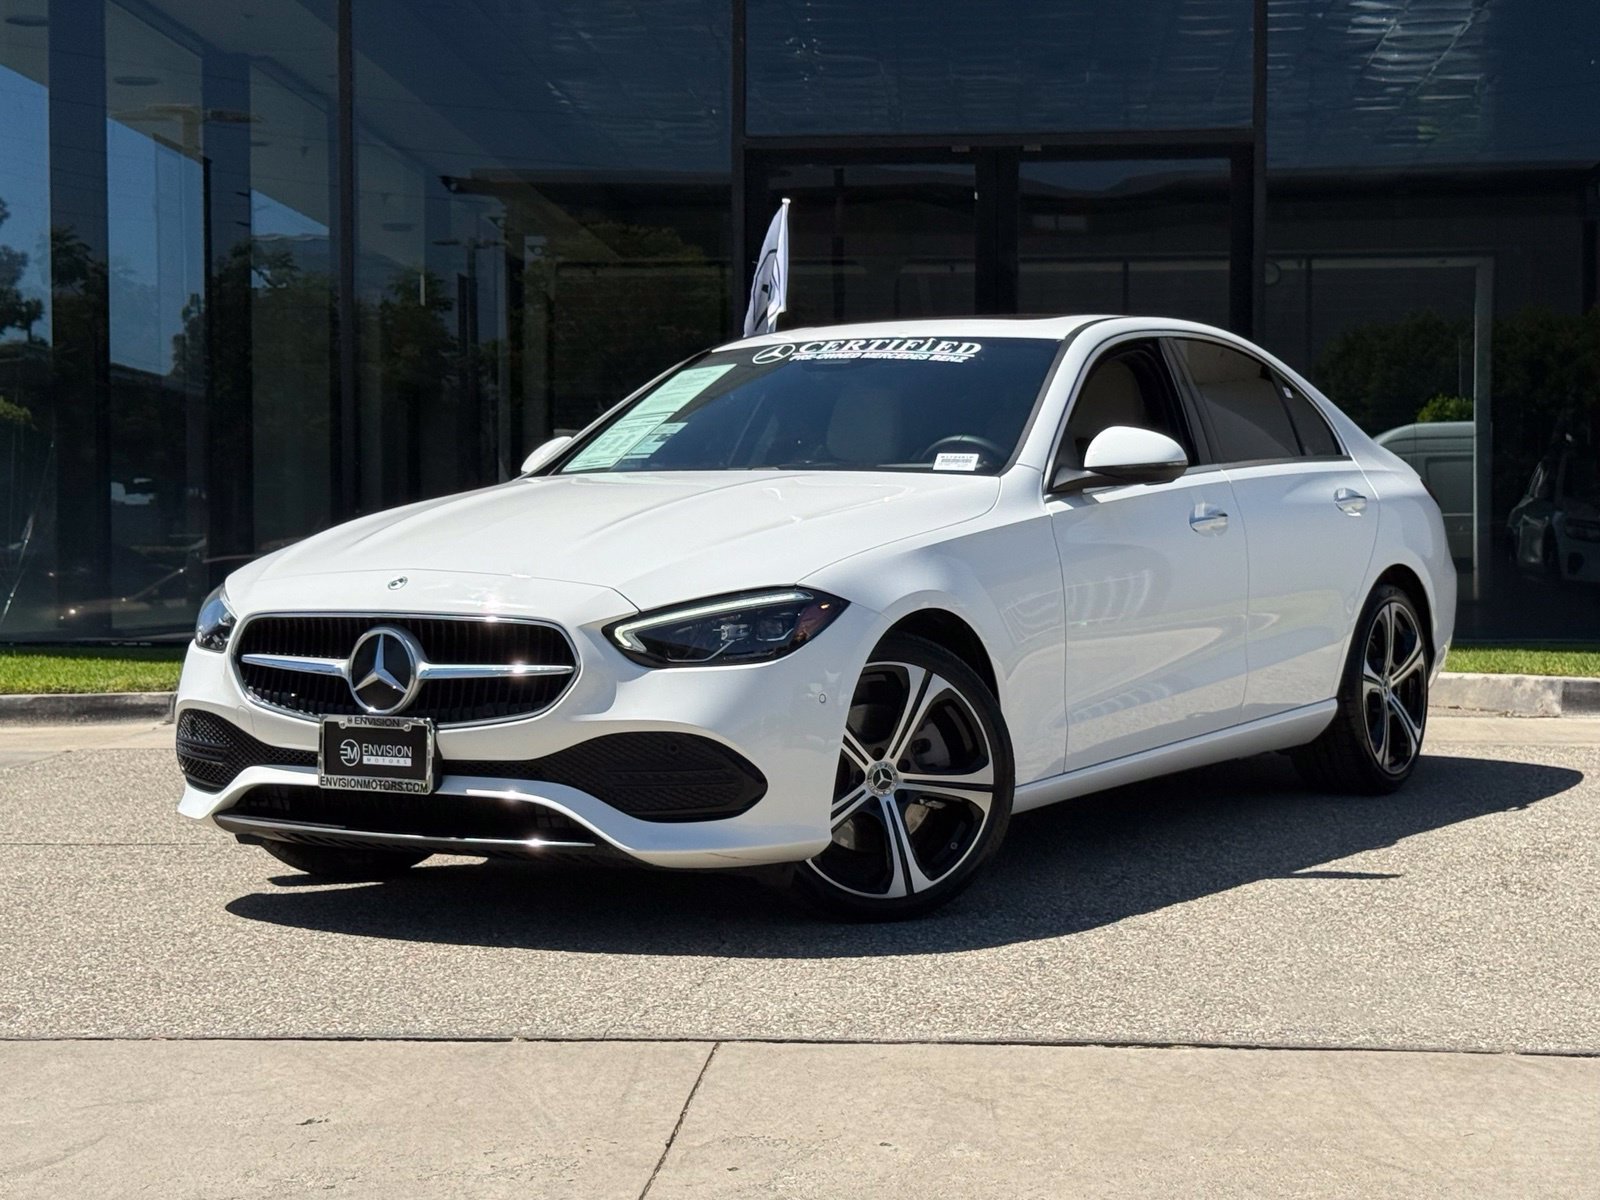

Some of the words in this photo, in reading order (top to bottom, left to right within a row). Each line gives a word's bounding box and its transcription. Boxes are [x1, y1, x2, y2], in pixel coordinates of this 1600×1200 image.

[799, 338, 982, 355] CERTIFIED
[860, 352, 930, 361] MERCEDES
[928, 354, 969, 363] BENZ
[354, 716, 400, 727] ENVISION
[362, 743, 412, 757] ENVISION
[366, 757, 408, 765] MOTORS
[320, 775, 428, 793] ENVISIONMOTORS.COM
